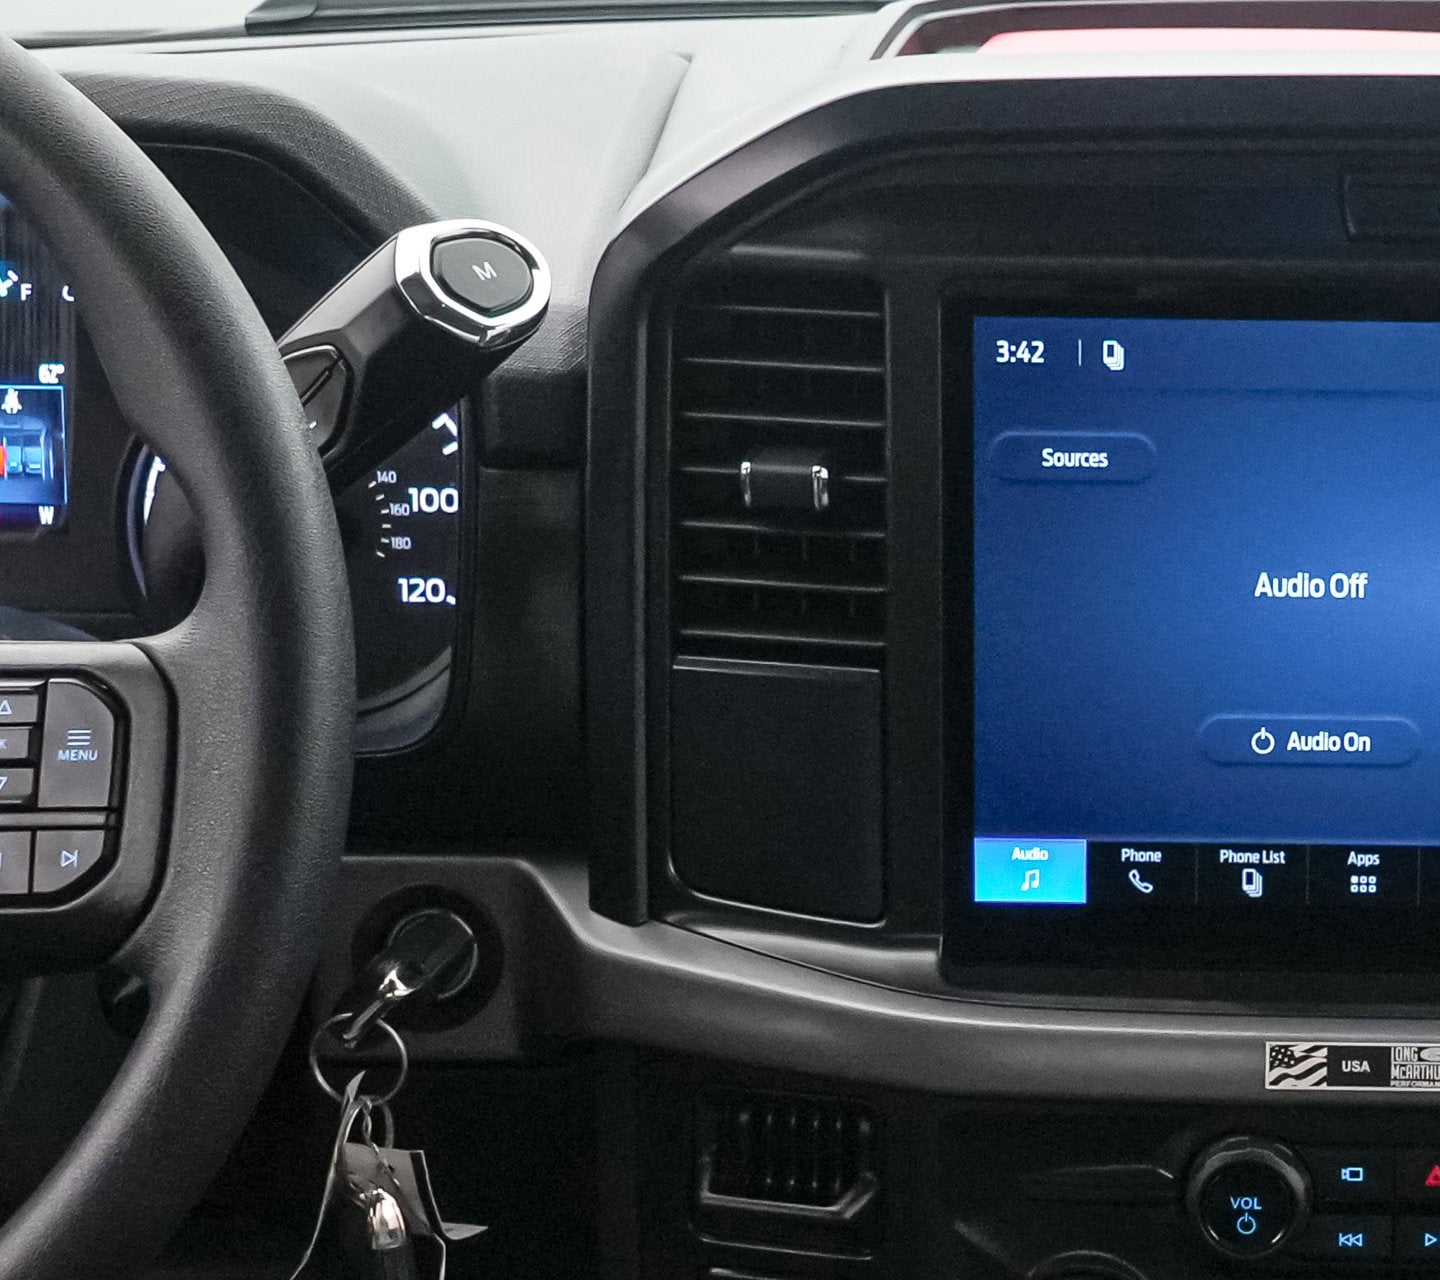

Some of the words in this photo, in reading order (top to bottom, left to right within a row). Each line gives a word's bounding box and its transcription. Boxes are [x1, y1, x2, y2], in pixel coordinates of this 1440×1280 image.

[472, 261, 497, 281] M
[21, 283, 31, 300] F
[997, 340, 1044, 363] 3:42
[1042, 448, 1108, 467] Sources
[377, 471, 397, 484] 140
[408, 486, 459, 514] 100
[39, 506, 54, 524] W
[390, 503, 409, 516] 160
[391, 537, 411, 549] 180
[398, 577, 446, 603] 120
[1255, 572, 1324, 597] Audio
[1329, 572, 1369, 597] Off
[1287, 731, 1340, 752] Audio
[1343, 731, 1371, 752] On
[57, 749, 98, 761] MENU
[1011, 847, 1049, 862] Audio
[1122, 848, 1161, 862] Phone
[1220, 849, 1260, 863] Phone
[1263, 850, 1285, 864] List
[1348, 851, 1380, 867] Apps
[1391, 1047, 1418, 1062] LONG
[1342, 1060, 1371, 1073] USA
[1230, 1196, 1262, 1210] VOL
